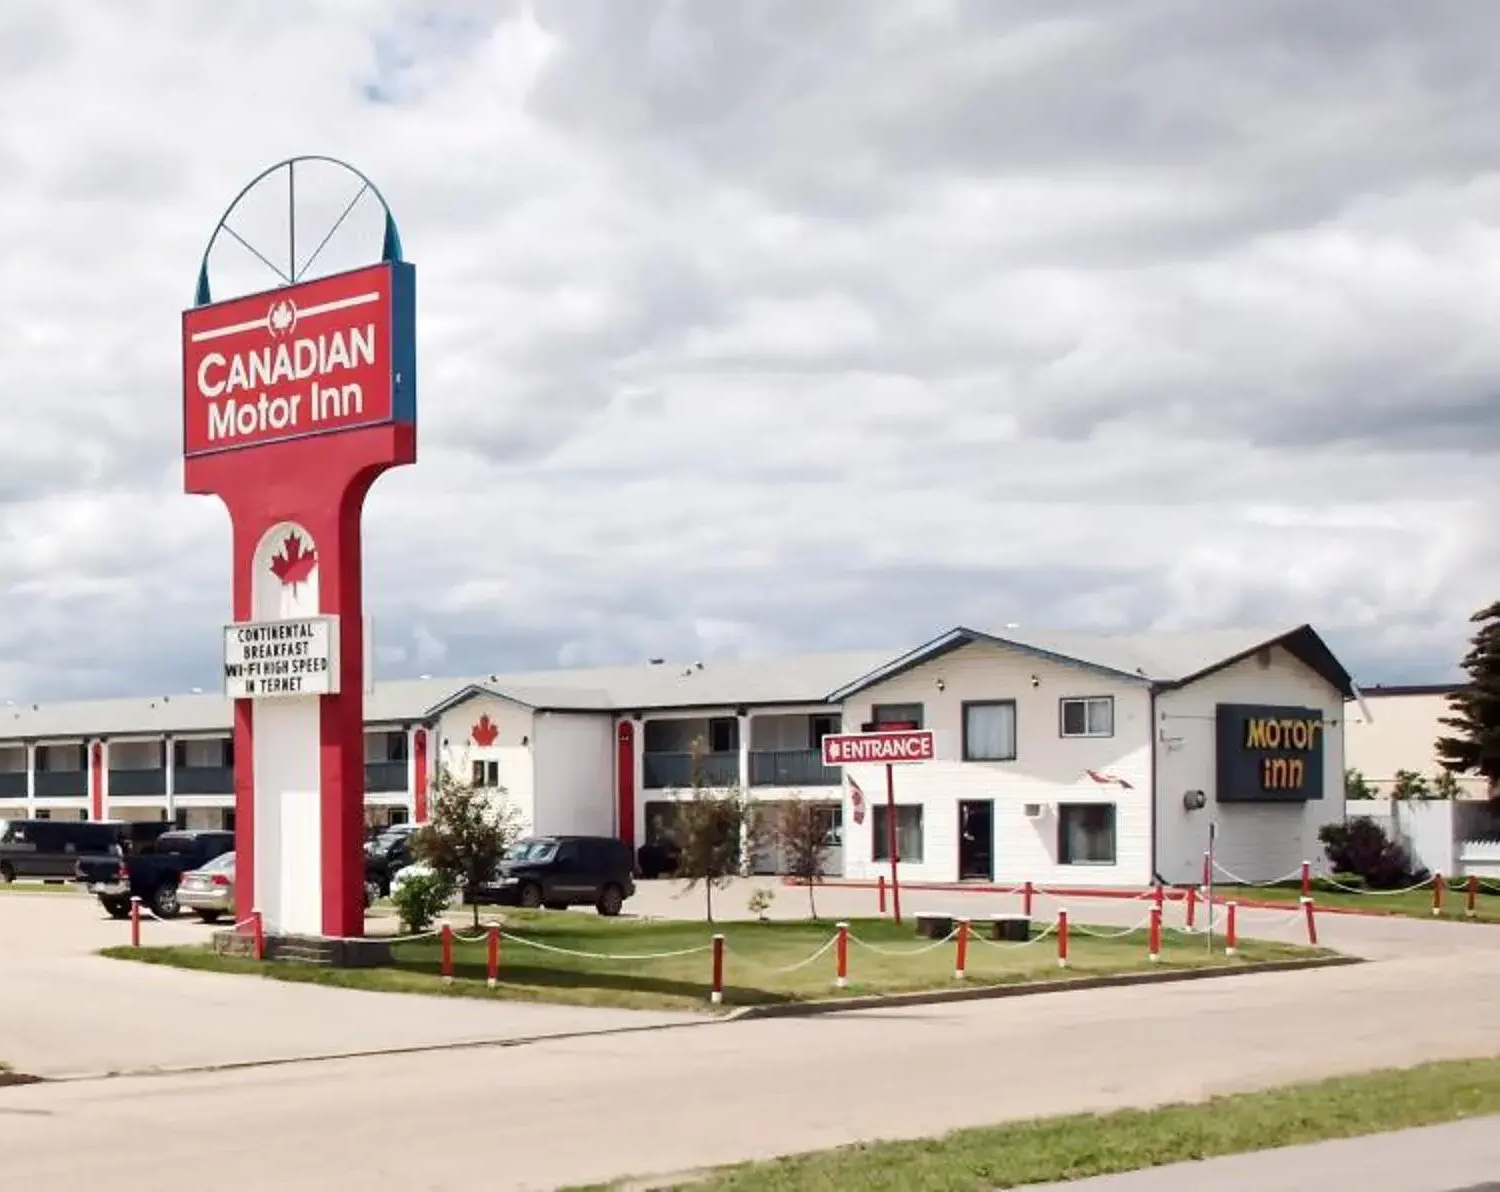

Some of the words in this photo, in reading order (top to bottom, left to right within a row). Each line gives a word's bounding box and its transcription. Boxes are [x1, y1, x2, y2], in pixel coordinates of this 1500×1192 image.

[197, 324, 376, 397] CANADIAN
[207, 393, 300, 440] Motor
[311, 382, 363, 421] Inn
[238, 623, 314, 642] CONTINENTAL
[244, 641, 308, 660] BREAKFAST
[225, 662, 261, 677] WI-FI
[264, 660, 289, 675] HIGH
[292, 657, 328, 673] SPEED
[842, 737, 931, 759] ENTRANCE
